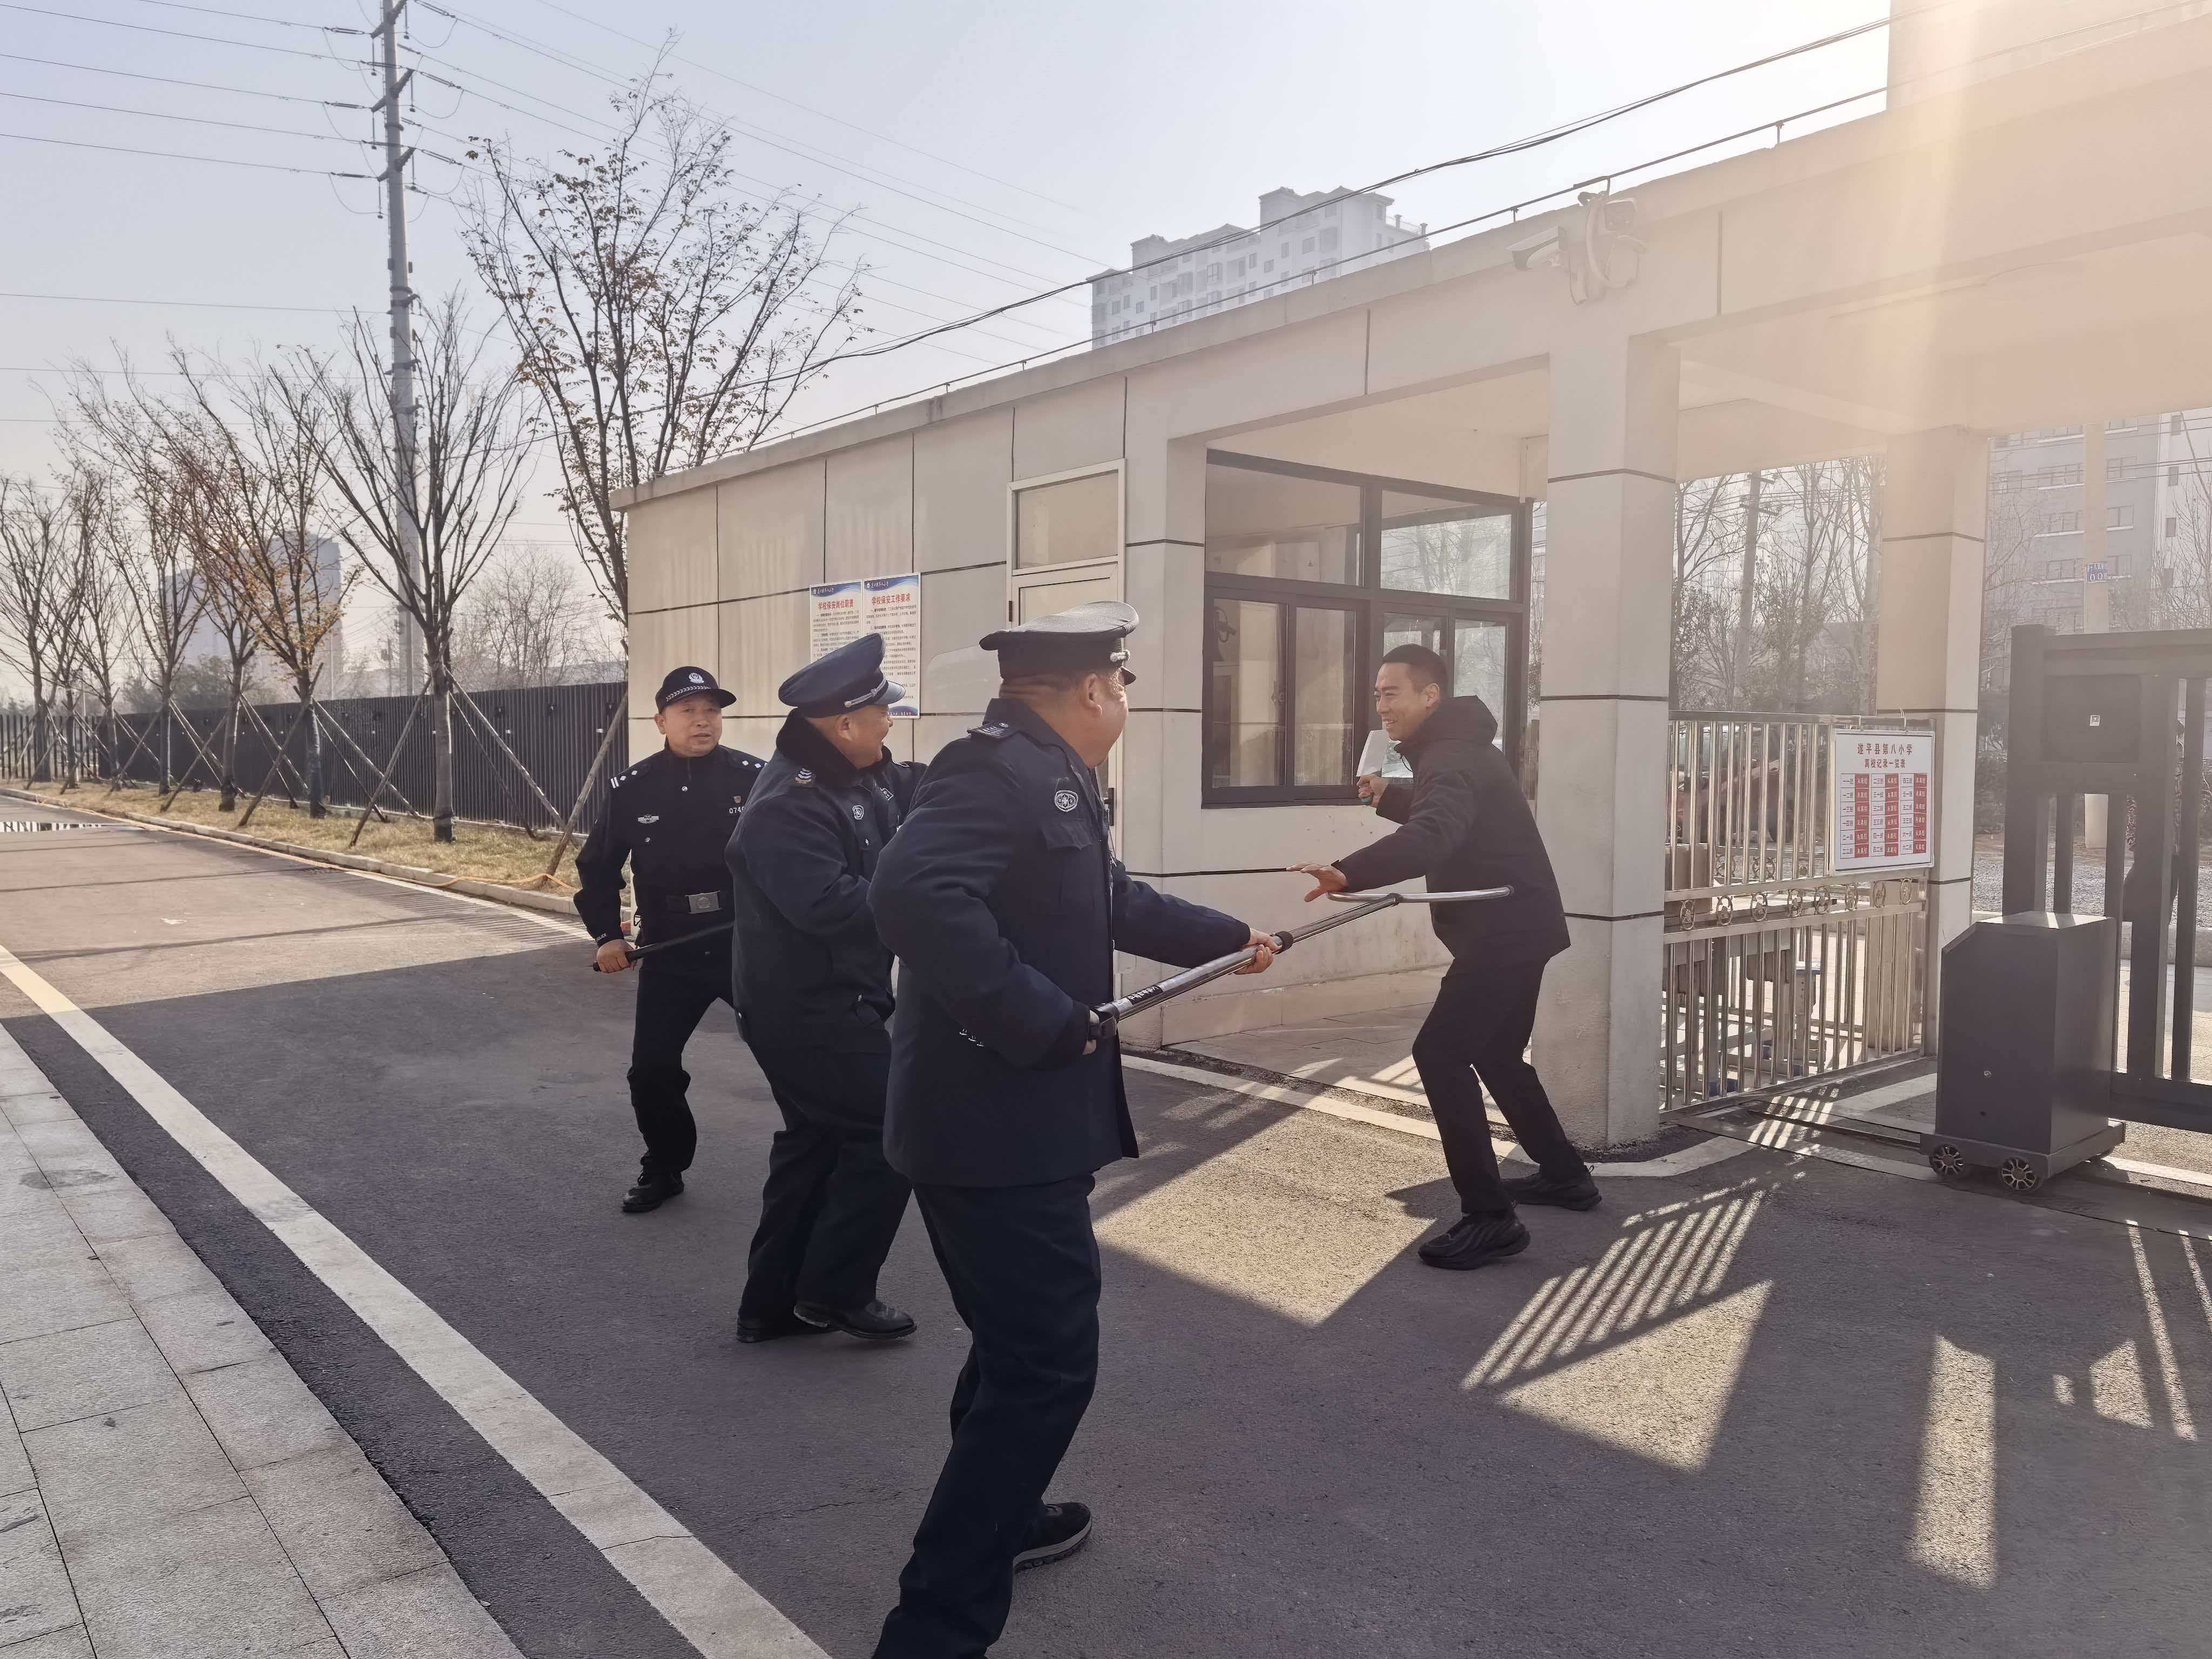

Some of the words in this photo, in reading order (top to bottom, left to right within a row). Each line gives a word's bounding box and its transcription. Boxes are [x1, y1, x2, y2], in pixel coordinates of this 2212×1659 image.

[818, 599, 854, 610] 学校保安岗位职责
[872, 593, 911, 605] 学校保安工作要求
[1857, 743, 1912, 755] 遂平县第八小学
